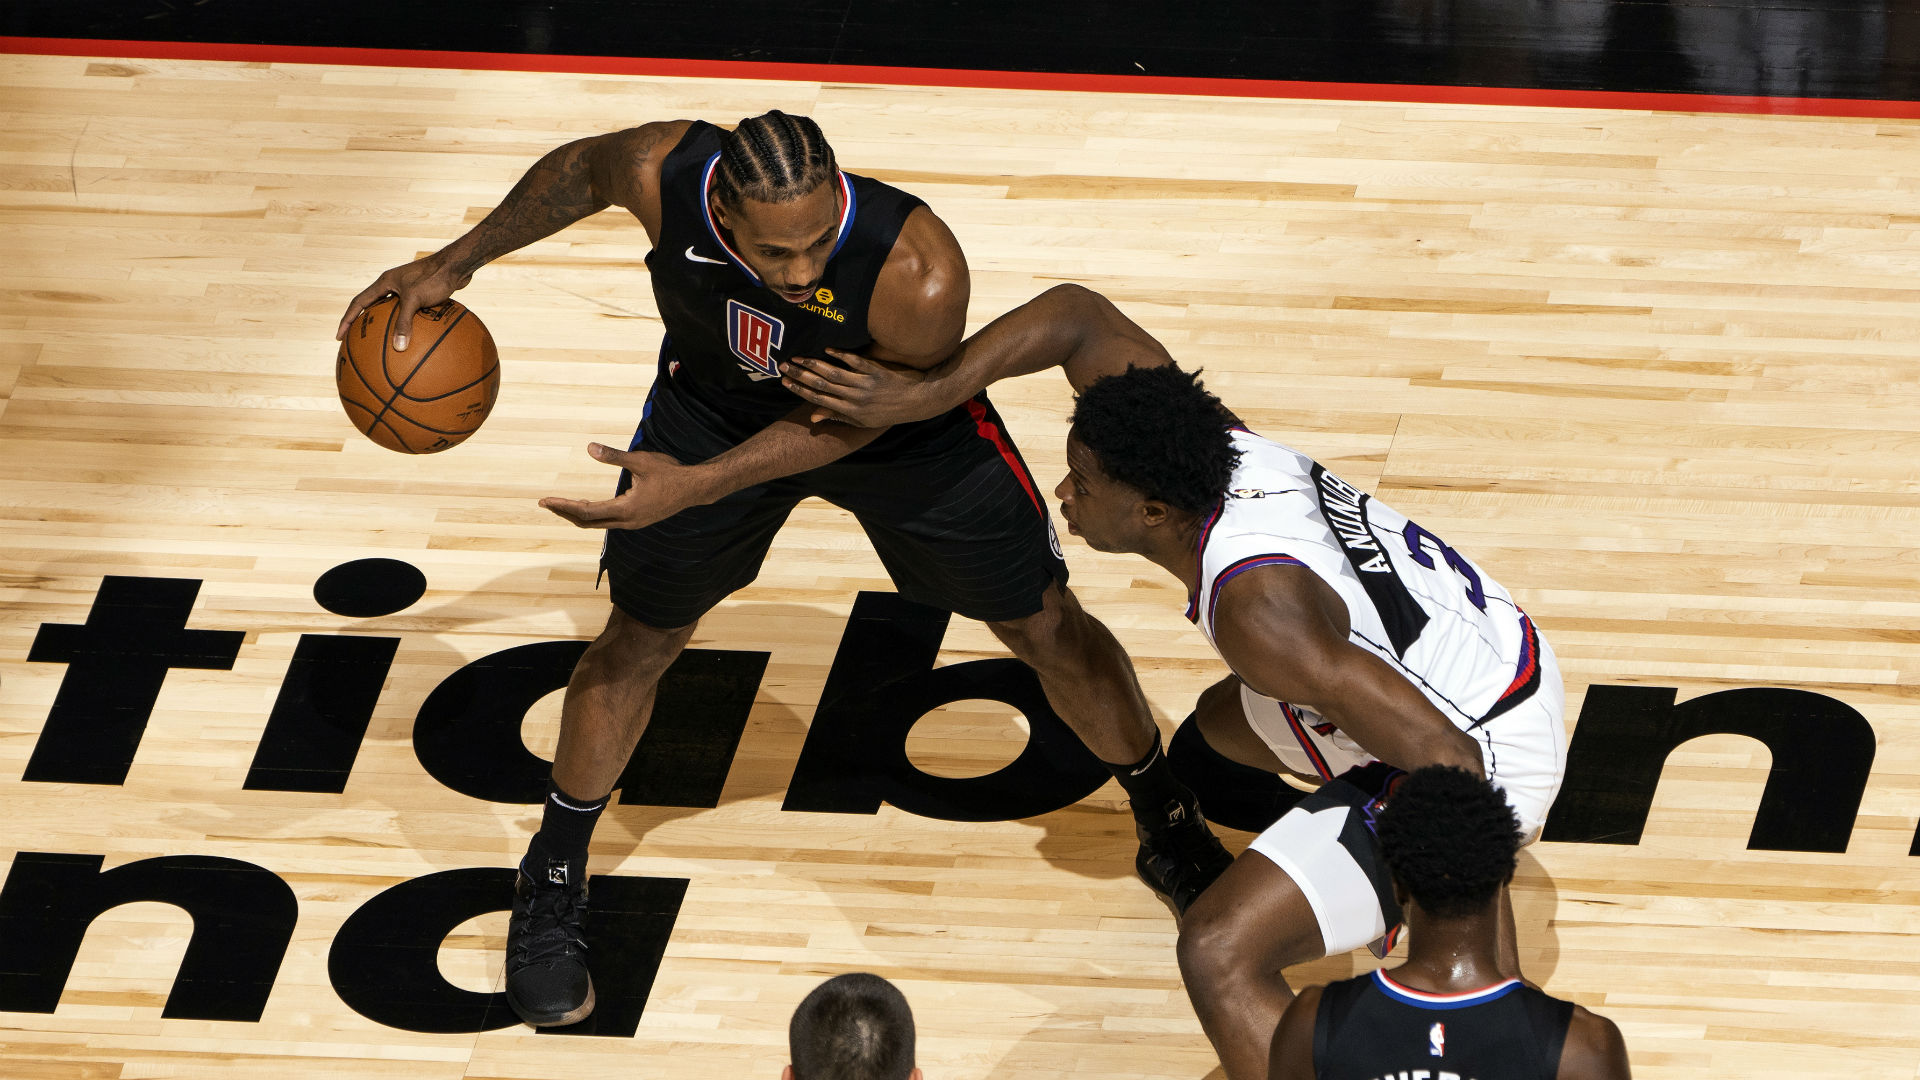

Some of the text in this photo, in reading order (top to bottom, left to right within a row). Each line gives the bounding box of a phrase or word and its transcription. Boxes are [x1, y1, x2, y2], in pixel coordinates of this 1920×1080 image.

[1319, 470, 1392, 574] ANUNOB
[1402, 519, 1488, 618] 3
[26, 557, 1920, 857] tiabn
